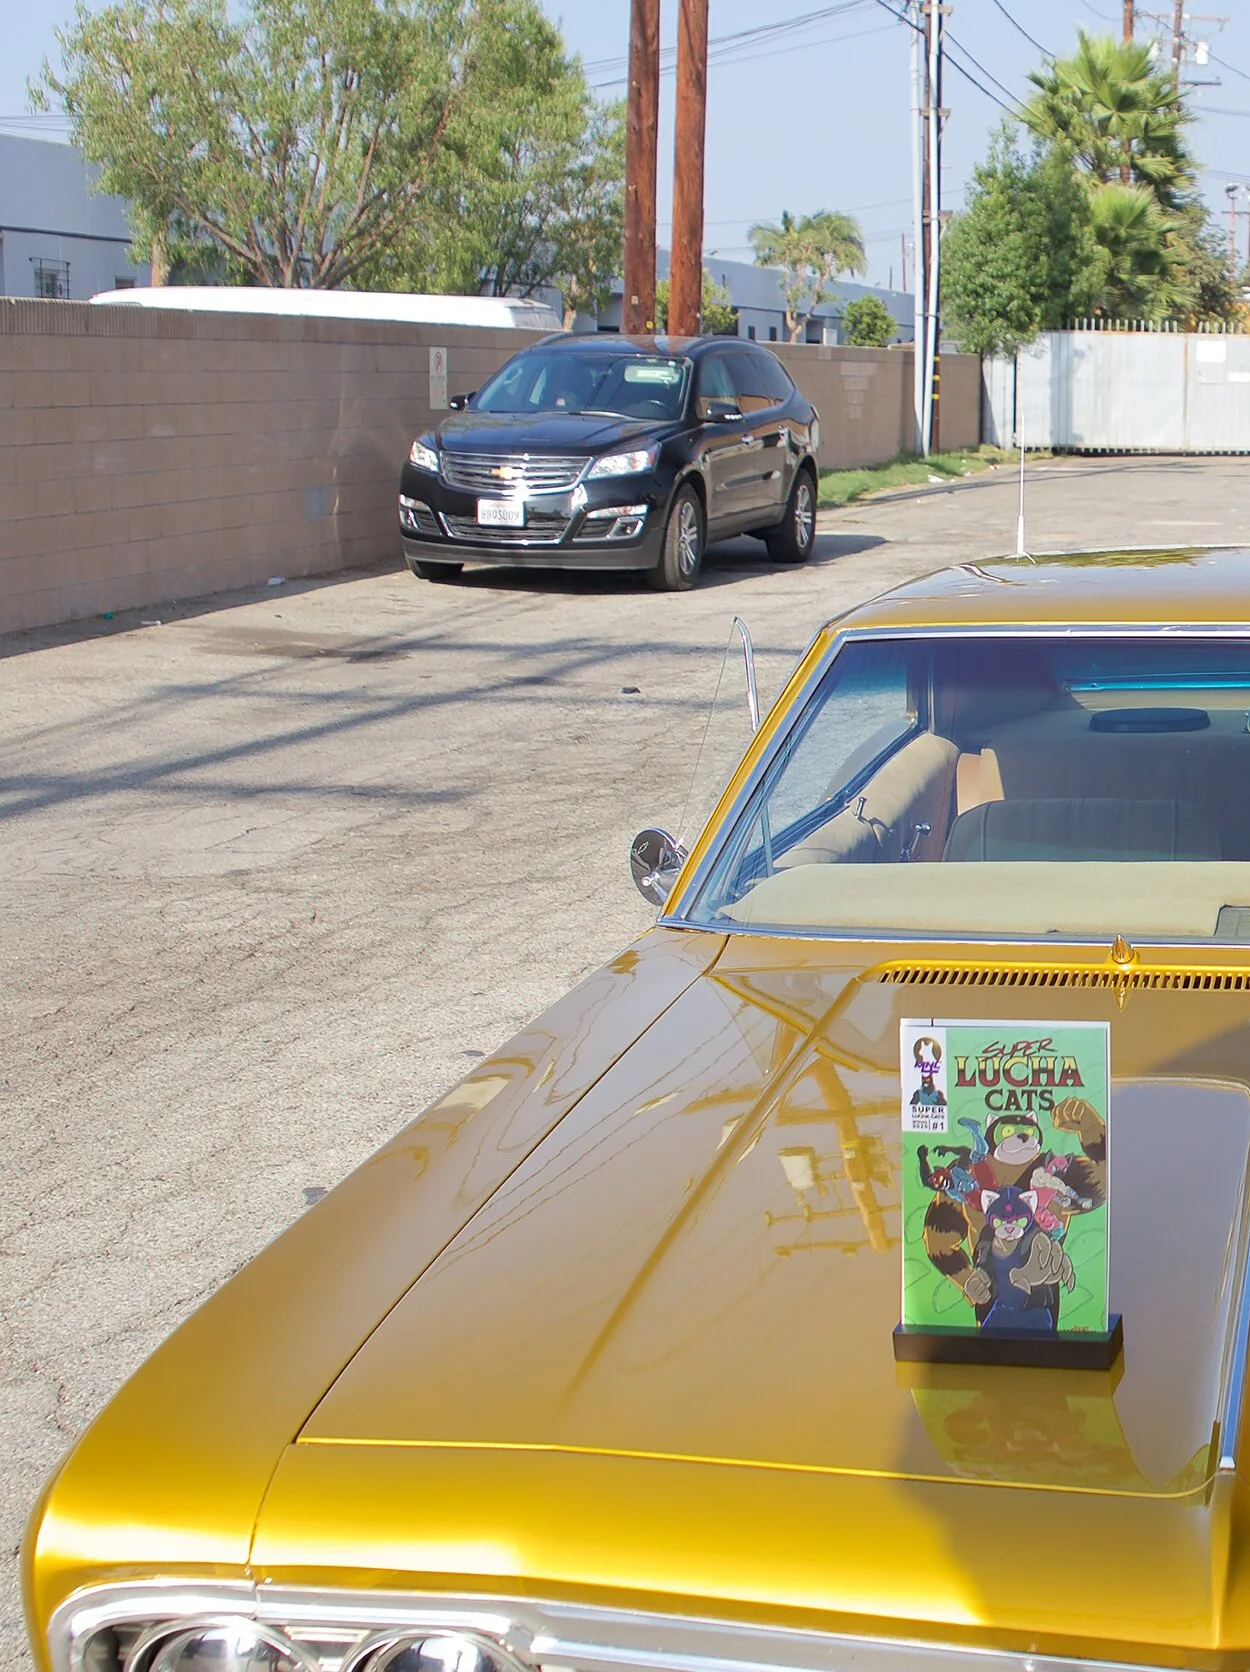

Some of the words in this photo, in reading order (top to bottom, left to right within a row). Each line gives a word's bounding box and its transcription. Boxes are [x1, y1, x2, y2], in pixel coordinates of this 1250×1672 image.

[981, 1038, 1058, 1062] SUPER
[954, 1056, 1085, 1087] LUCHA
[984, 1088, 1056, 1112] CATS
